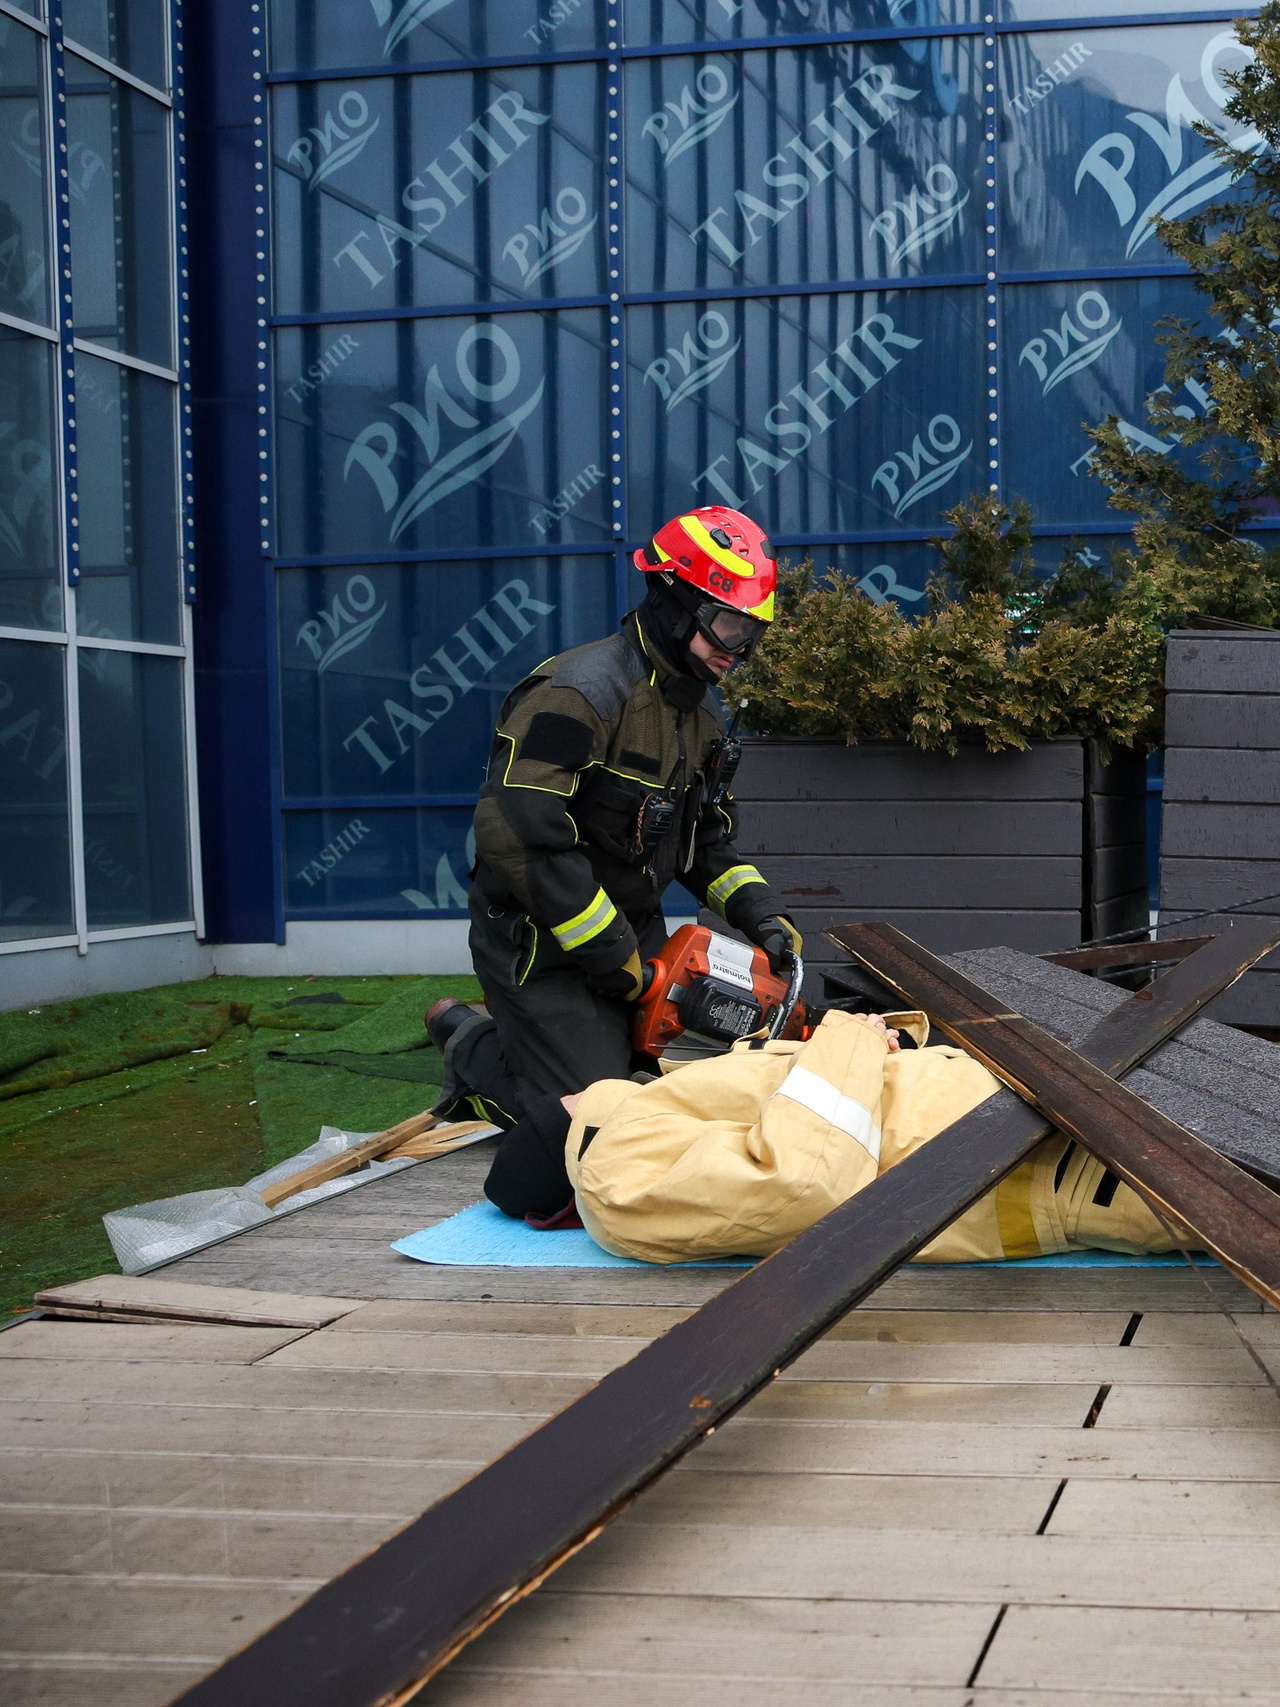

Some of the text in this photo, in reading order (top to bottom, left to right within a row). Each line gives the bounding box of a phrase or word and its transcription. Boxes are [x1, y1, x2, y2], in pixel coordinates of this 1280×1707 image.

[523, 0, 580, 45] TASH
[1008, 42, 1093, 116] TASHIR
[333, 90, 551, 289] TASHIR
[689, 65, 920, 267] TASHIR
[284, 333, 360, 404] TASHIR
[692, 312, 923, 508] TASHIR
[528, 463, 606, 535] TASHIR
[343, 578, 556, 774] TASHIR
[297, 818, 371, 888] TASHIR
[713, 964, 751, 984] holmatro
